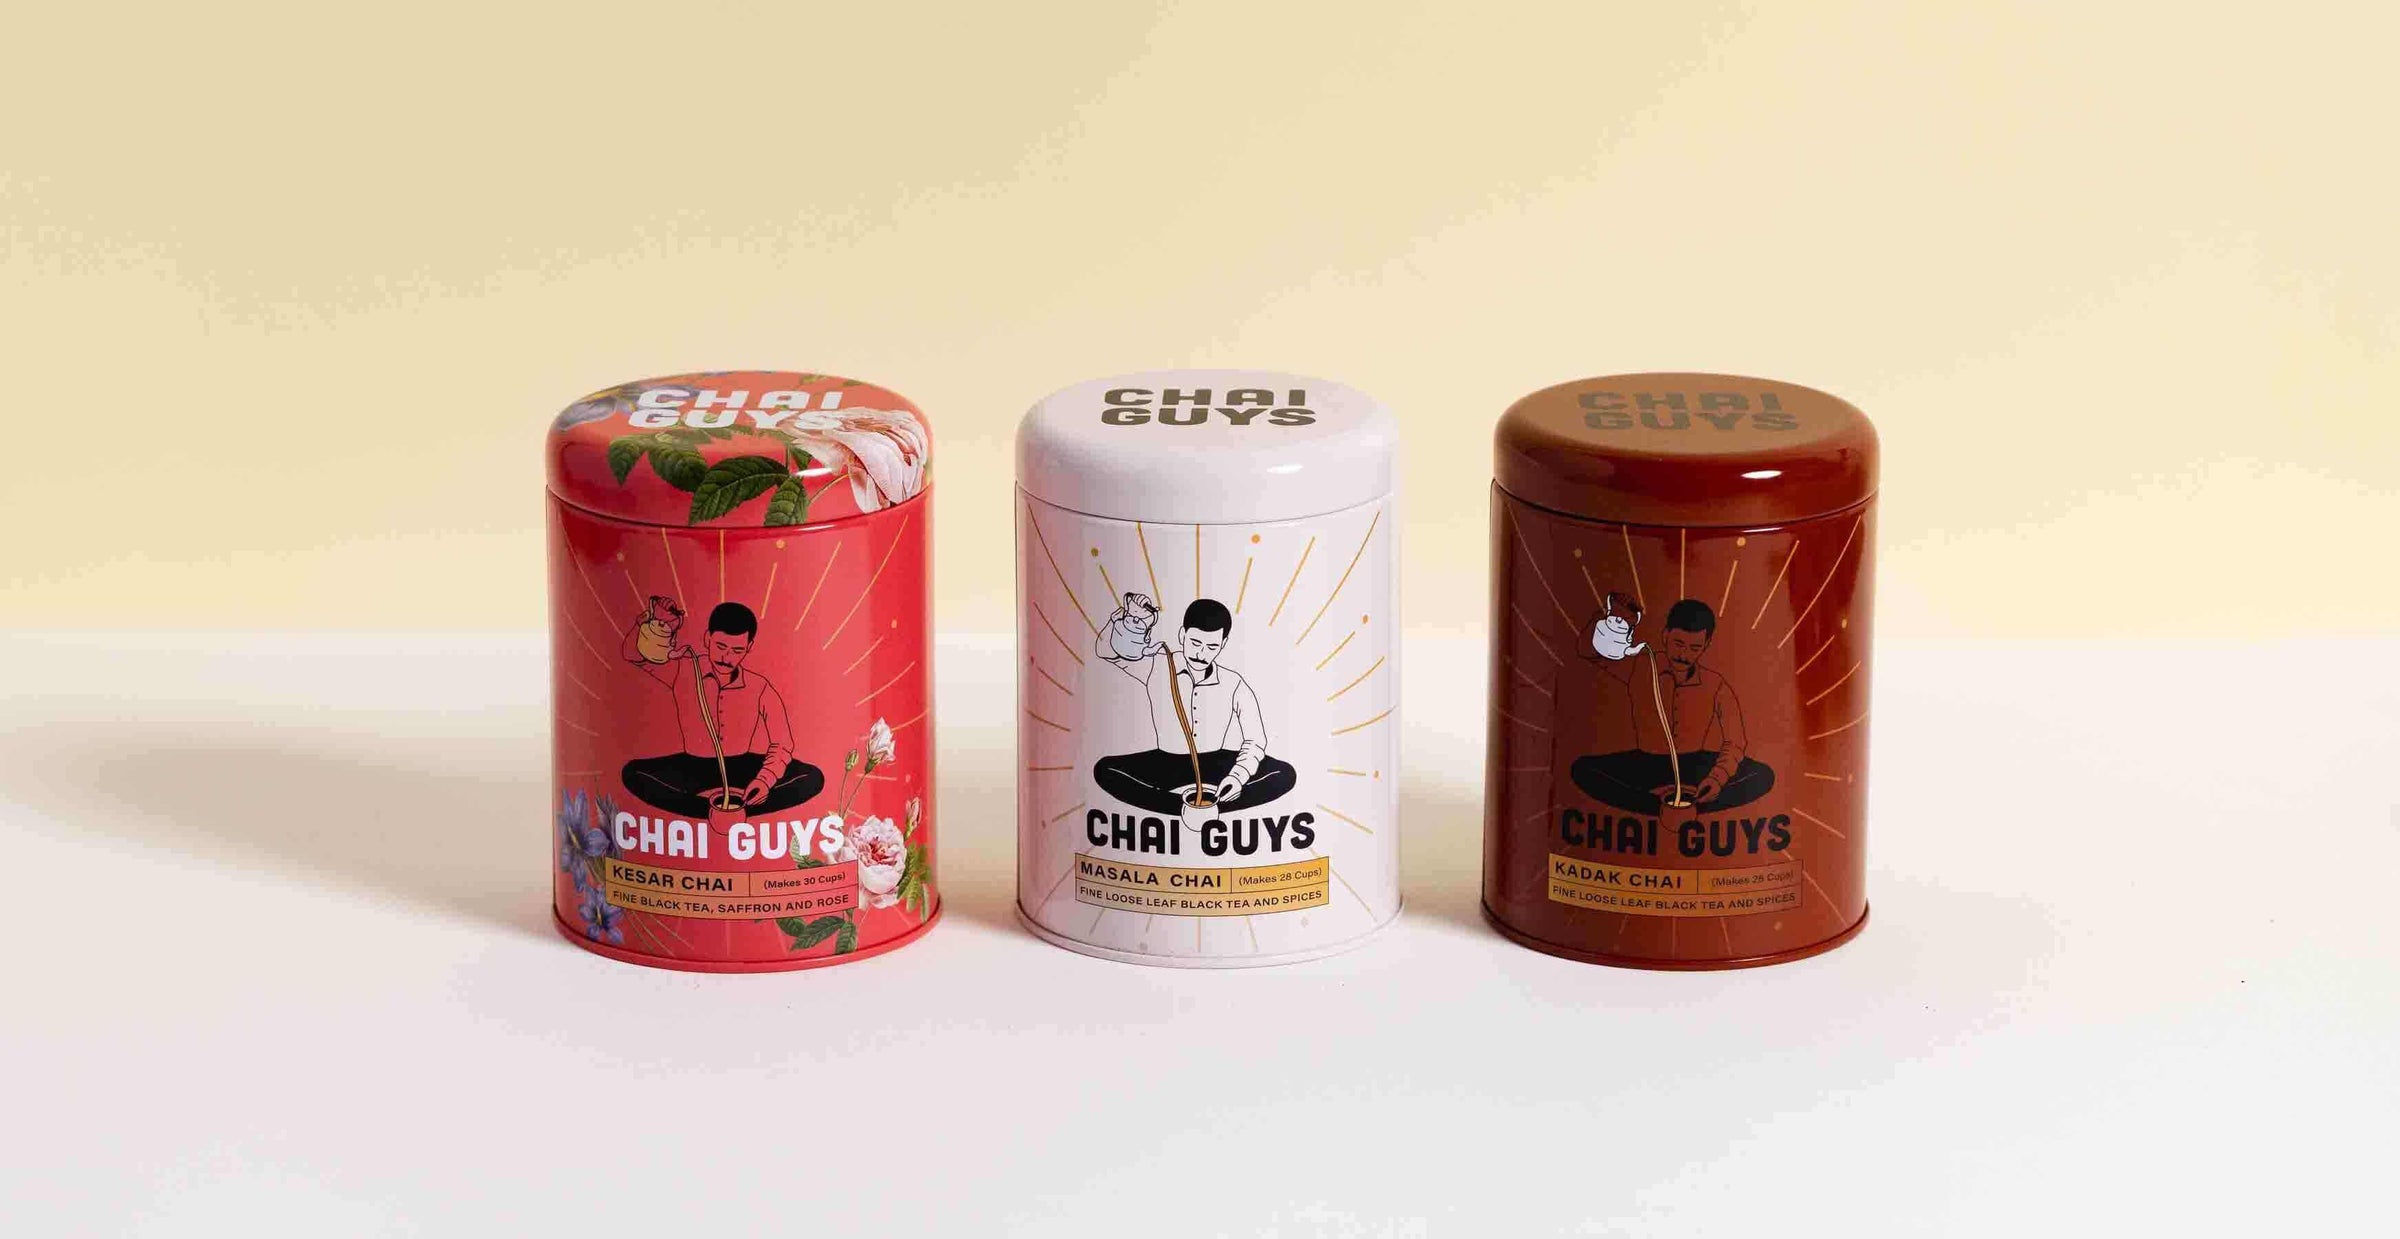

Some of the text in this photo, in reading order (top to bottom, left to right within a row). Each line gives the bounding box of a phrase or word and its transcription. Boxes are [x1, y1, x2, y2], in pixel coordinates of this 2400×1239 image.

[637, 390, 843, 410] CHAI
[1104, 388, 1306, 406] CHAI
[1578, 392, 1783, 411] CHAI
[628, 409, 843, 429] GUYS
[1101, 407, 1316, 426] GUYS
[1584, 411, 1799, 431] GUYS
[615, 811, 844, 861] CHAI GUYS
[1086, 809, 1315, 857] CHAI GUYS
[1561, 809, 1791, 858] CHAI GUYS
[613, 865, 733, 892] KESAR CHAI
[763, 871, 846, 890] (Makes 30 Cups)
[1080, 861, 1222, 888] MASALA CHAI
[1238, 867, 1322, 886] (Makes 28 Cups)
[1555, 863, 1682, 888] KADAK CHAI
[1711, 877, 1750, 888] (Makes
[1767, 869, 1794, 883] Cups)
[613, 891, 849, 914] FINE BLACK TEA, SAFFRON AND ROSE
[1080, 886, 1322, 909] FINE LOOSE LEAF BLACK TEA AND SPICES
[1553, 886, 1796, 910] FINE LOOSE LEAF BLACK TEA AND SPICES
